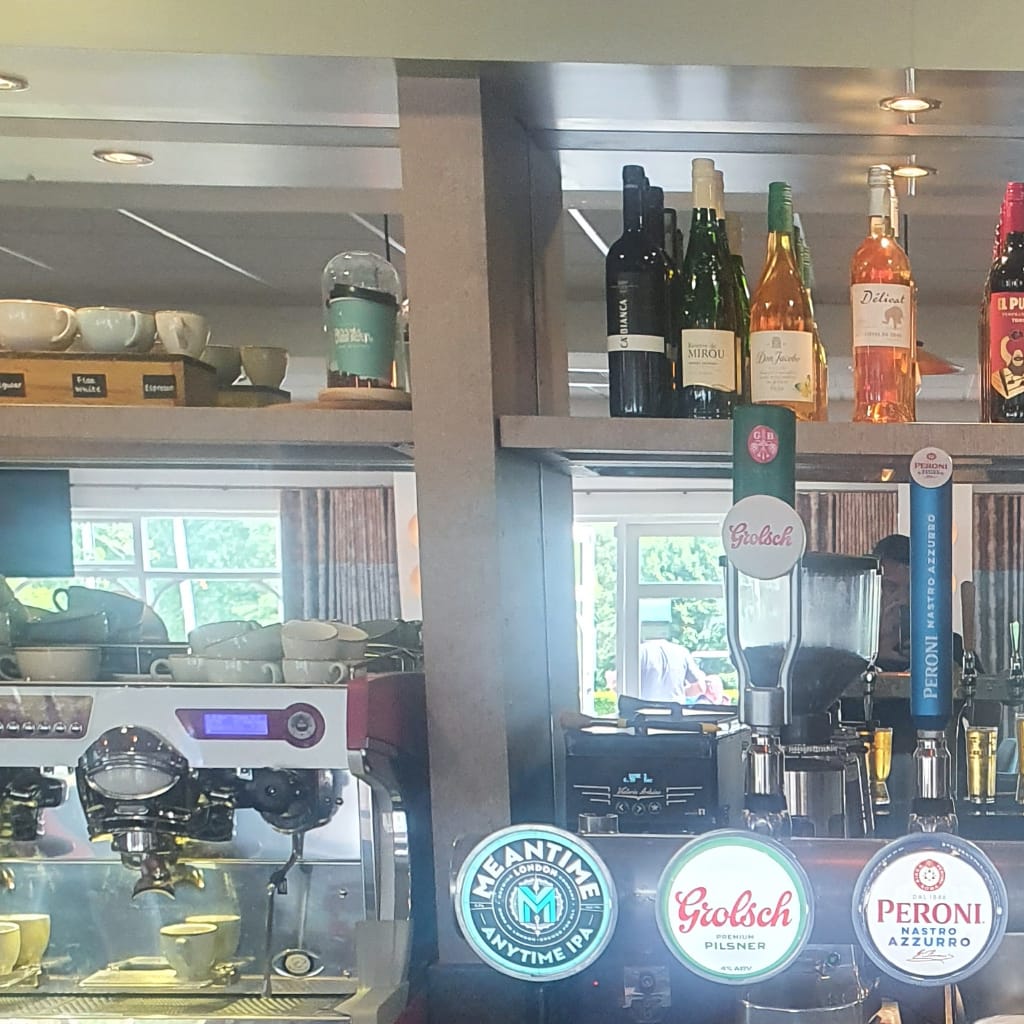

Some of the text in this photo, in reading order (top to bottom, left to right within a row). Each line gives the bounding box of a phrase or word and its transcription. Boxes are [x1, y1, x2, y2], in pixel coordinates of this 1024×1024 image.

[860, 289, 905, 305] Délicat
[997, 296, 1008, 311] EL
[729, 522, 794, 549] Grolsch
[923, 513, 938, 700] PERONI NASTRO AZZURRO
[472, 840, 601, 901] MEANTIME
[512, 863, 559, 878] LONDON
[674, 886, 793, 934] Grolsch
[877, 899, 985, 925] PERONI
[888, 937, 971, 947] AZZURRO
[901, 927, 957, 936] NASTRO
[481, 926, 594, 965] ANYTIME IPA
[704, 941, 766, 951] PILSNER
